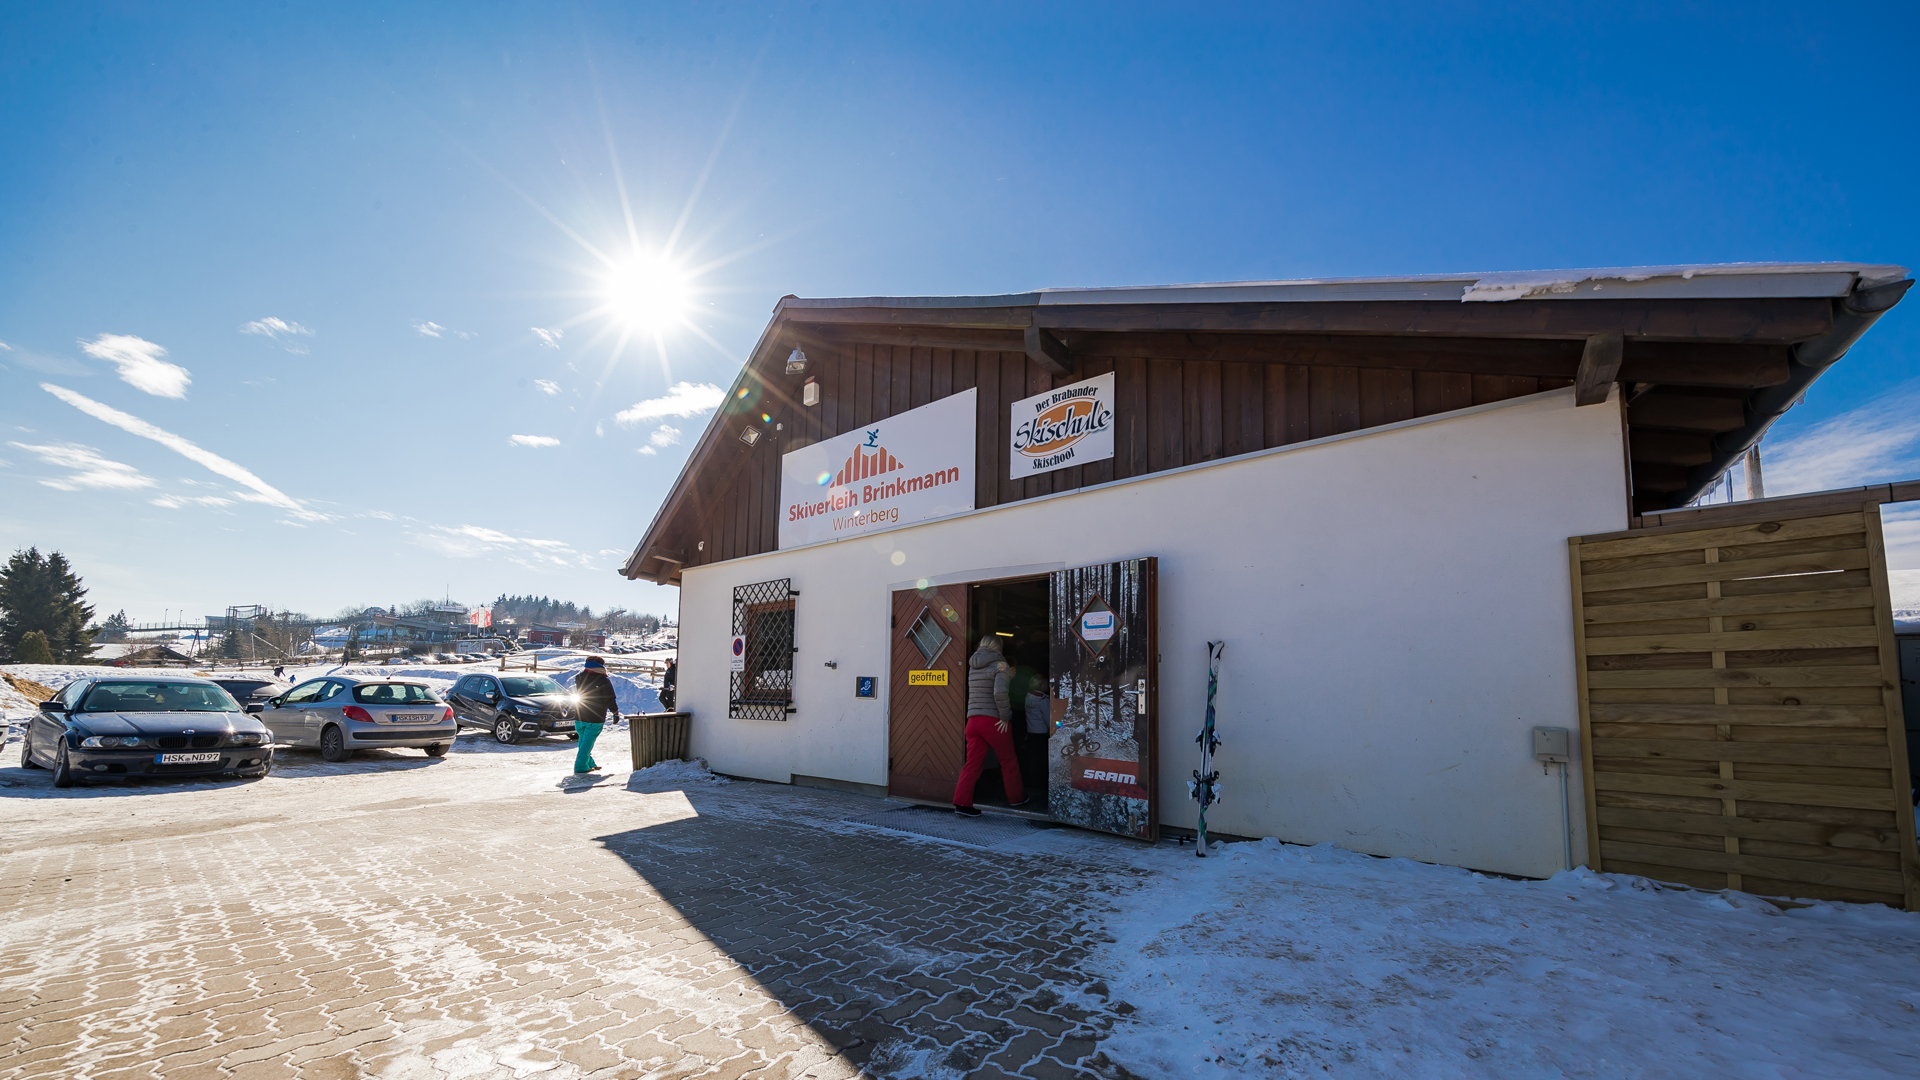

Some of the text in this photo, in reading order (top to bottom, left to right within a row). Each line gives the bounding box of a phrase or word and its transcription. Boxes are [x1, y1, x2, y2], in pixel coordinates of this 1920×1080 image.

[1035, 386, 1098, 413] Der Brabander
[1013, 400, 1111, 449] Skischule
[1032, 447, 1075, 470] Skischool
[788, 466, 959, 522] Skiverleih Brinkmann
[832, 507, 899, 531] Winterberg
[910, 672, 946, 684] geöffnet
[163, 754, 185, 762] HSK
[1083, 769, 1136, 785] SRAM
